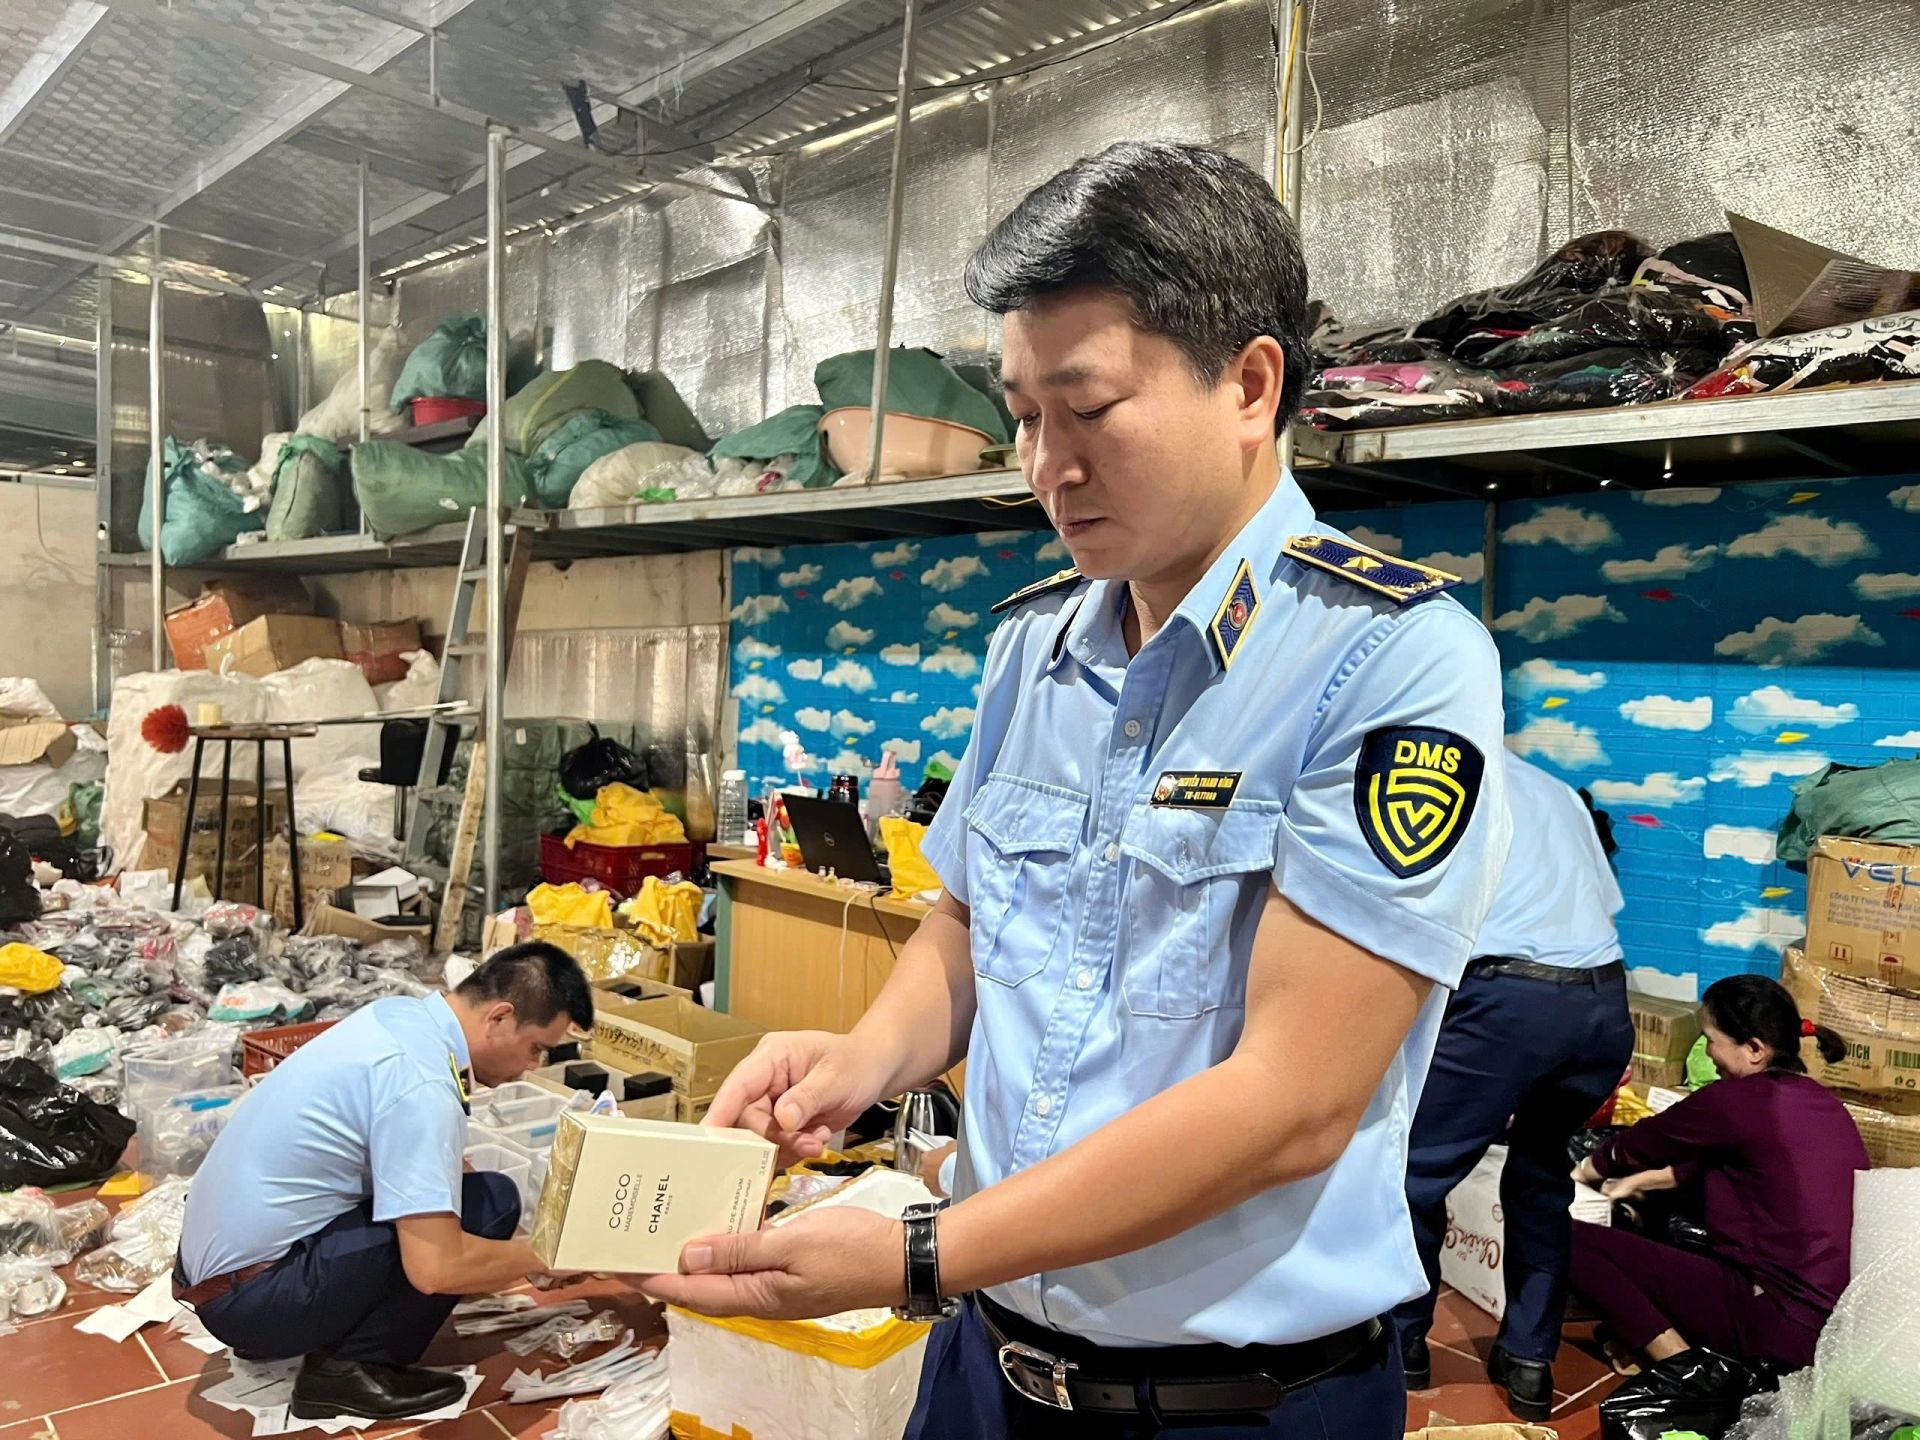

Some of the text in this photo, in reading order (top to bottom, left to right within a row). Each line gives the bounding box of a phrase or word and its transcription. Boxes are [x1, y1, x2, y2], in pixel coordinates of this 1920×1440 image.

[1394, 740, 1461, 774] DMS
[609, 1174, 631, 1229] COCO
[648, 1174, 670, 1234] CHANEL
[732, 1177, 744, 1211] PARFUM
